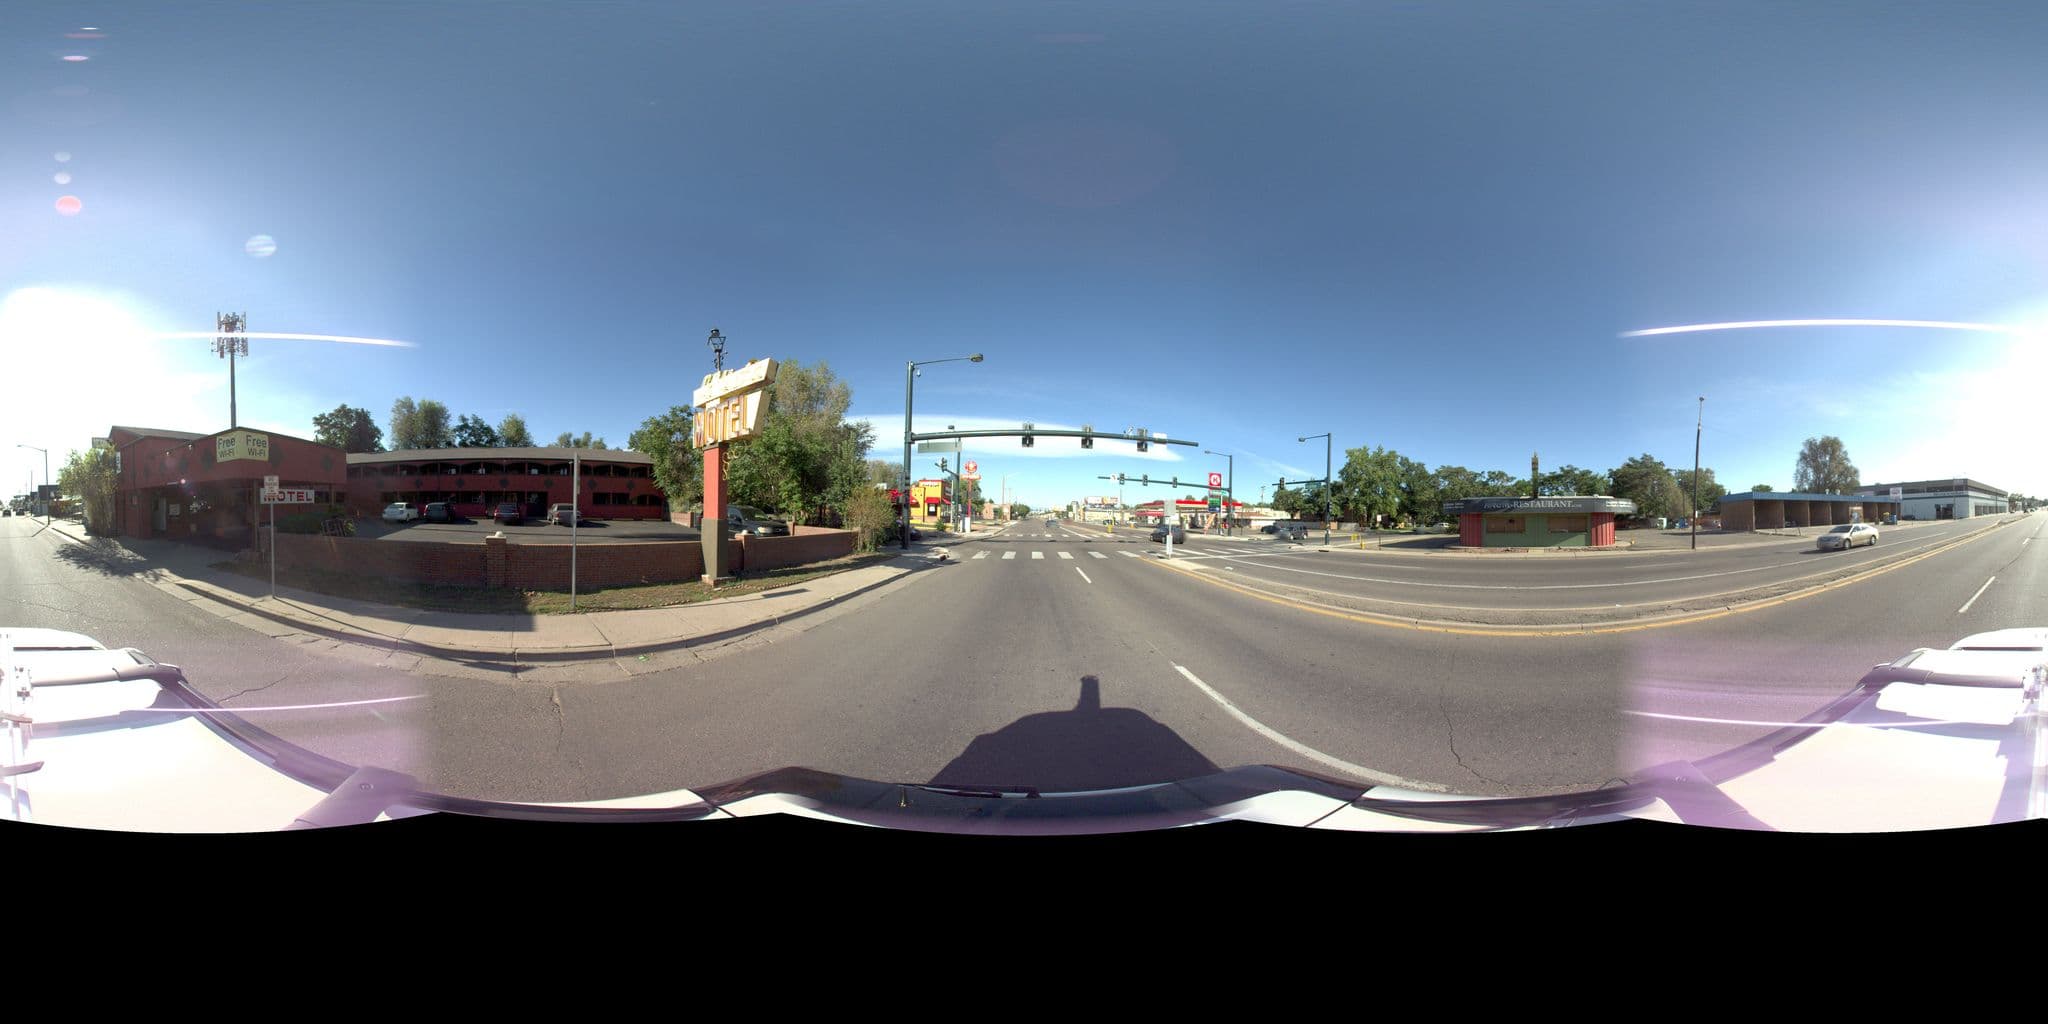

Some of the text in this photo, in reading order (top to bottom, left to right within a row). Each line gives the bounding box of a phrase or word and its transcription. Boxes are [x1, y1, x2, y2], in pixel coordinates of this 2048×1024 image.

[694, 394, 750, 447] MOTEL
[218, 438, 236, 449] Free
[246, 435, 267, 448] Free
